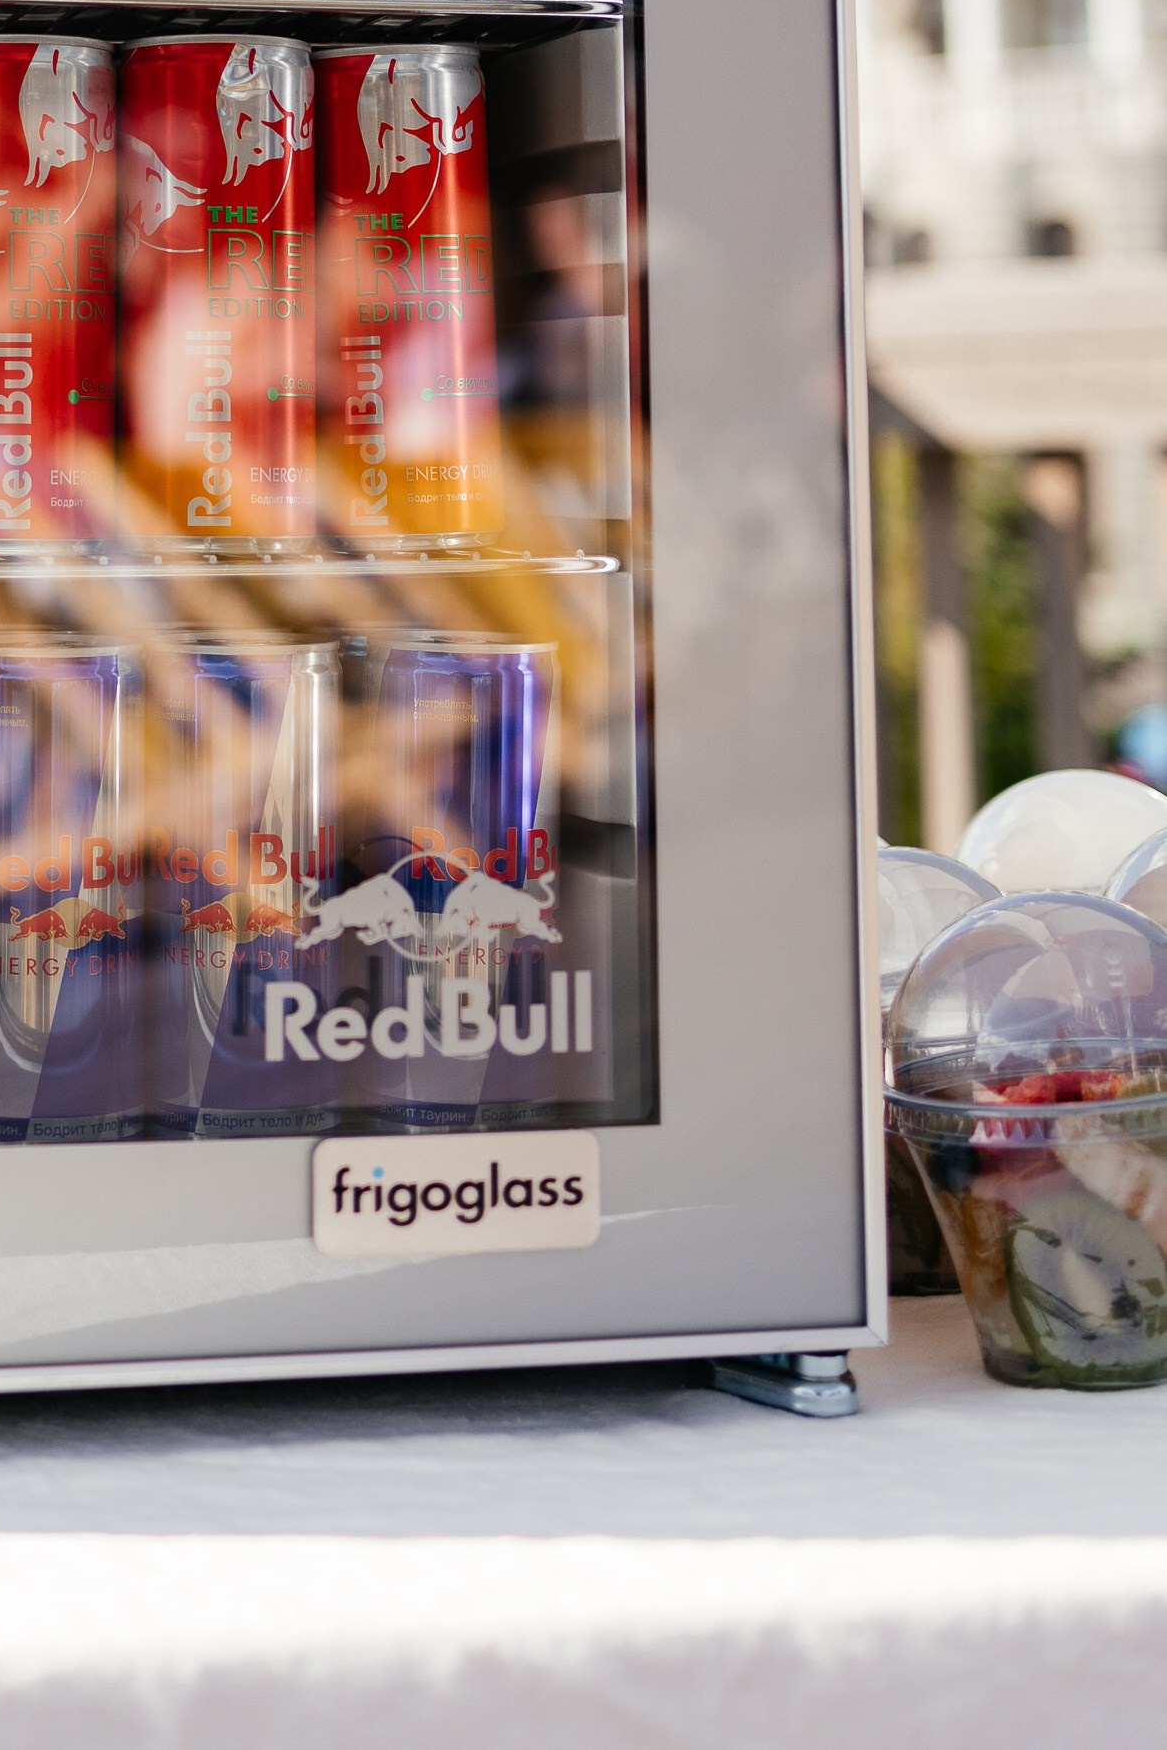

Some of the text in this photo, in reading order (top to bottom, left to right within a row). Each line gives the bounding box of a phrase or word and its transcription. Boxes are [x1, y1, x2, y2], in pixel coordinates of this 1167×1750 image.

[8, 207, 60, 226] THE
[208, 206, 259, 224] THE
[353, 213, 404, 231] THE
[355, 233, 493, 295] RED
[8, 298, 106, 323] EDITION
[208, 296, 305, 320] EDITION
[357, 300, 464, 323] EDITION
[184, 330, 233, 527] Red Bull
[340, 335, 389, 527] Red Bull
[250, 466, 303, 483] ENERGY
[406, 465, 468, 482] ENERGY
[250, 494, 284, 506] Бодрит
[408, 493, 443, 505] Бодрит
[413, 697, 472, 711] Употреблять
[413, 710, 479, 724] охлажденным.
[250, 825, 335, 885] Bull
[411, 825, 518, 882] Red
[163, 946, 327, 970] NERGY DRINK
[417, 944, 522, 966] ENERGY
[264, 969, 593, 1062] Red Bull
[202, 1113, 254, 1130] Бодрит
[259, 1115, 292, 1128] тело
[420, 1107, 470, 1124] таурин.
[481, 1107, 527, 1123] Бодрит
[34, 1122, 86, 1138] Бодрит
[92, 1121, 117, 1134] тело
[332, 1161, 584, 1228] frigoglass
